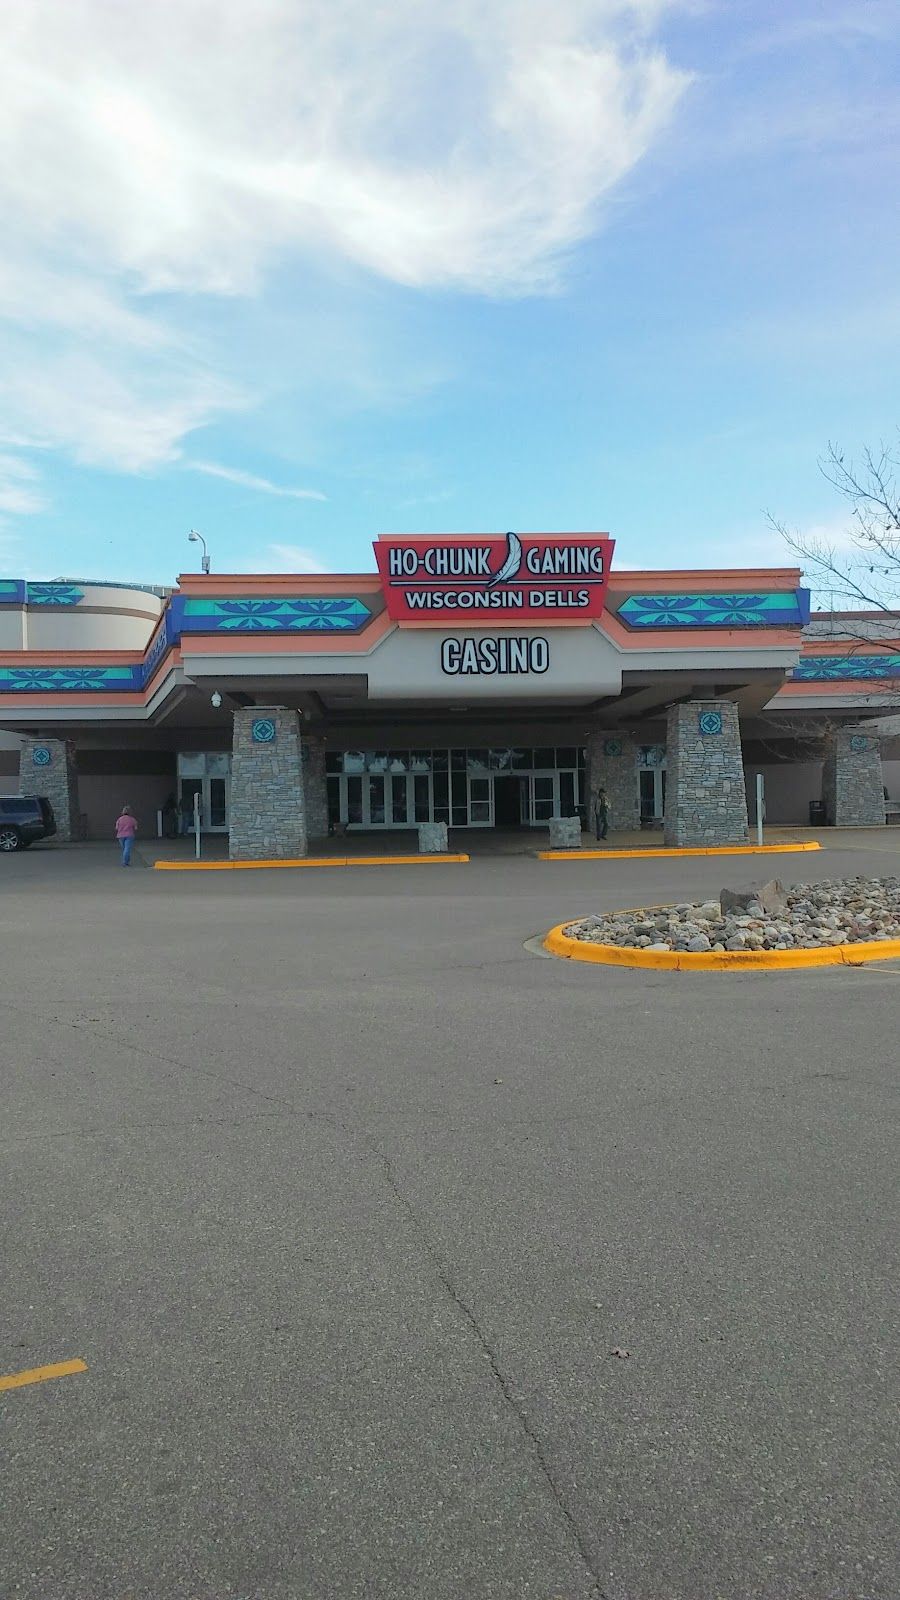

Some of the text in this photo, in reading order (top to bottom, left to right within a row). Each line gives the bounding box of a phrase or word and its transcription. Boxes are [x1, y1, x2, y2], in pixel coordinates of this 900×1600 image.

[389, 546, 603, 576] HO-CHUNK GAMING
[406, 590, 589, 608] WISCONSIN DELLS
[441, 637, 549, 675] CASINO
